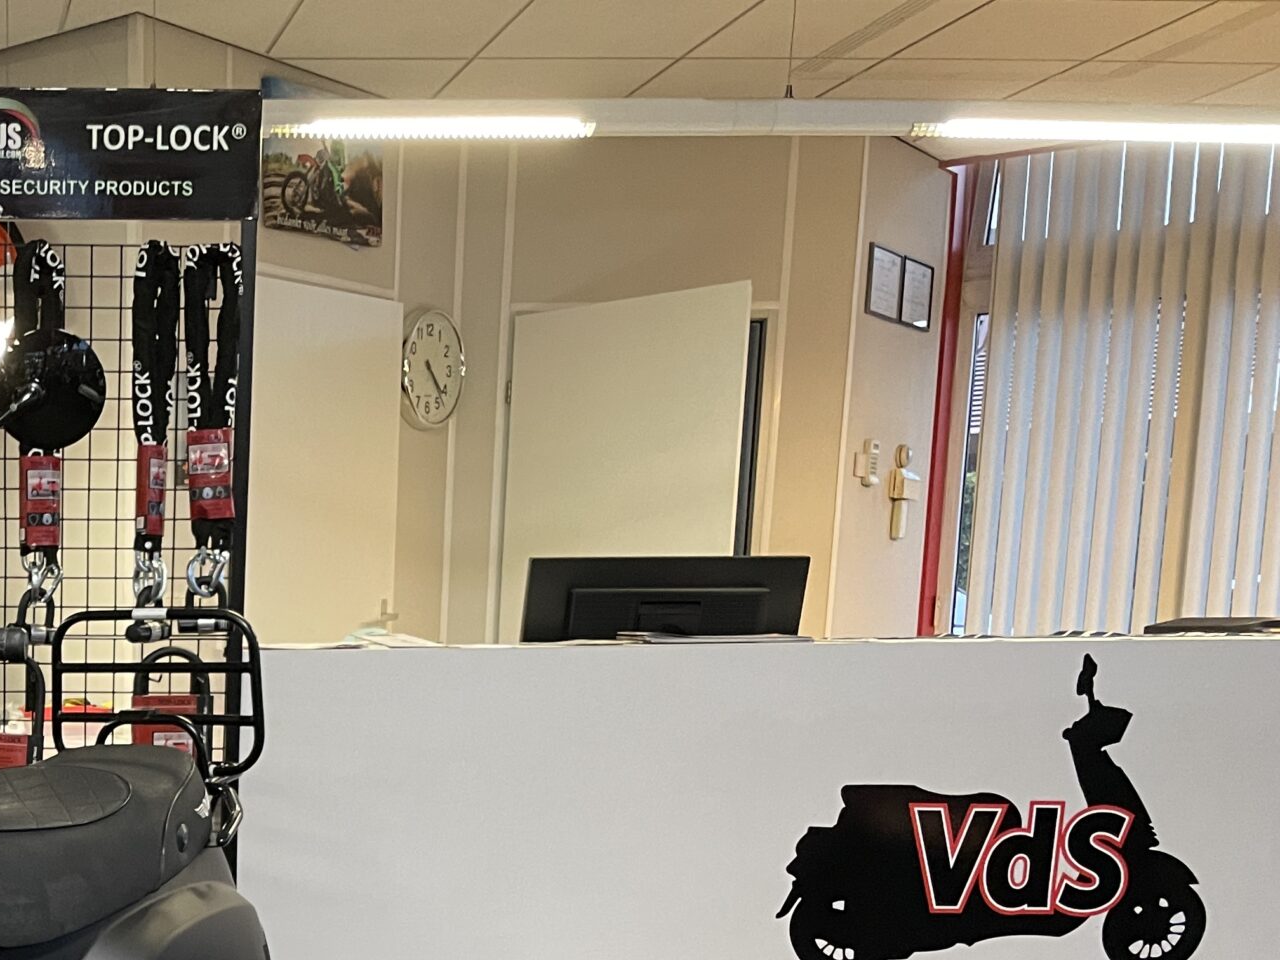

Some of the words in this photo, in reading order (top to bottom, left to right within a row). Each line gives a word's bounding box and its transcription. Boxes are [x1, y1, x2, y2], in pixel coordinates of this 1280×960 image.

[0, 178, 89, 197] SECURITY
[94, 179, 194, 197] PRODUCTS
[426, 323, 434, 337] 12
[438, 329, 442, 343] 1
[443, 344, 450, 359] 2
[446, 365, 452, 378] 3
[441, 383, 448, 397] 4
[415, 395, 421, 409] 7
[424, 401, 431, 415] 6
[434, 397, 441, 410] 5
[908, 800, 1135, 917] VdS
